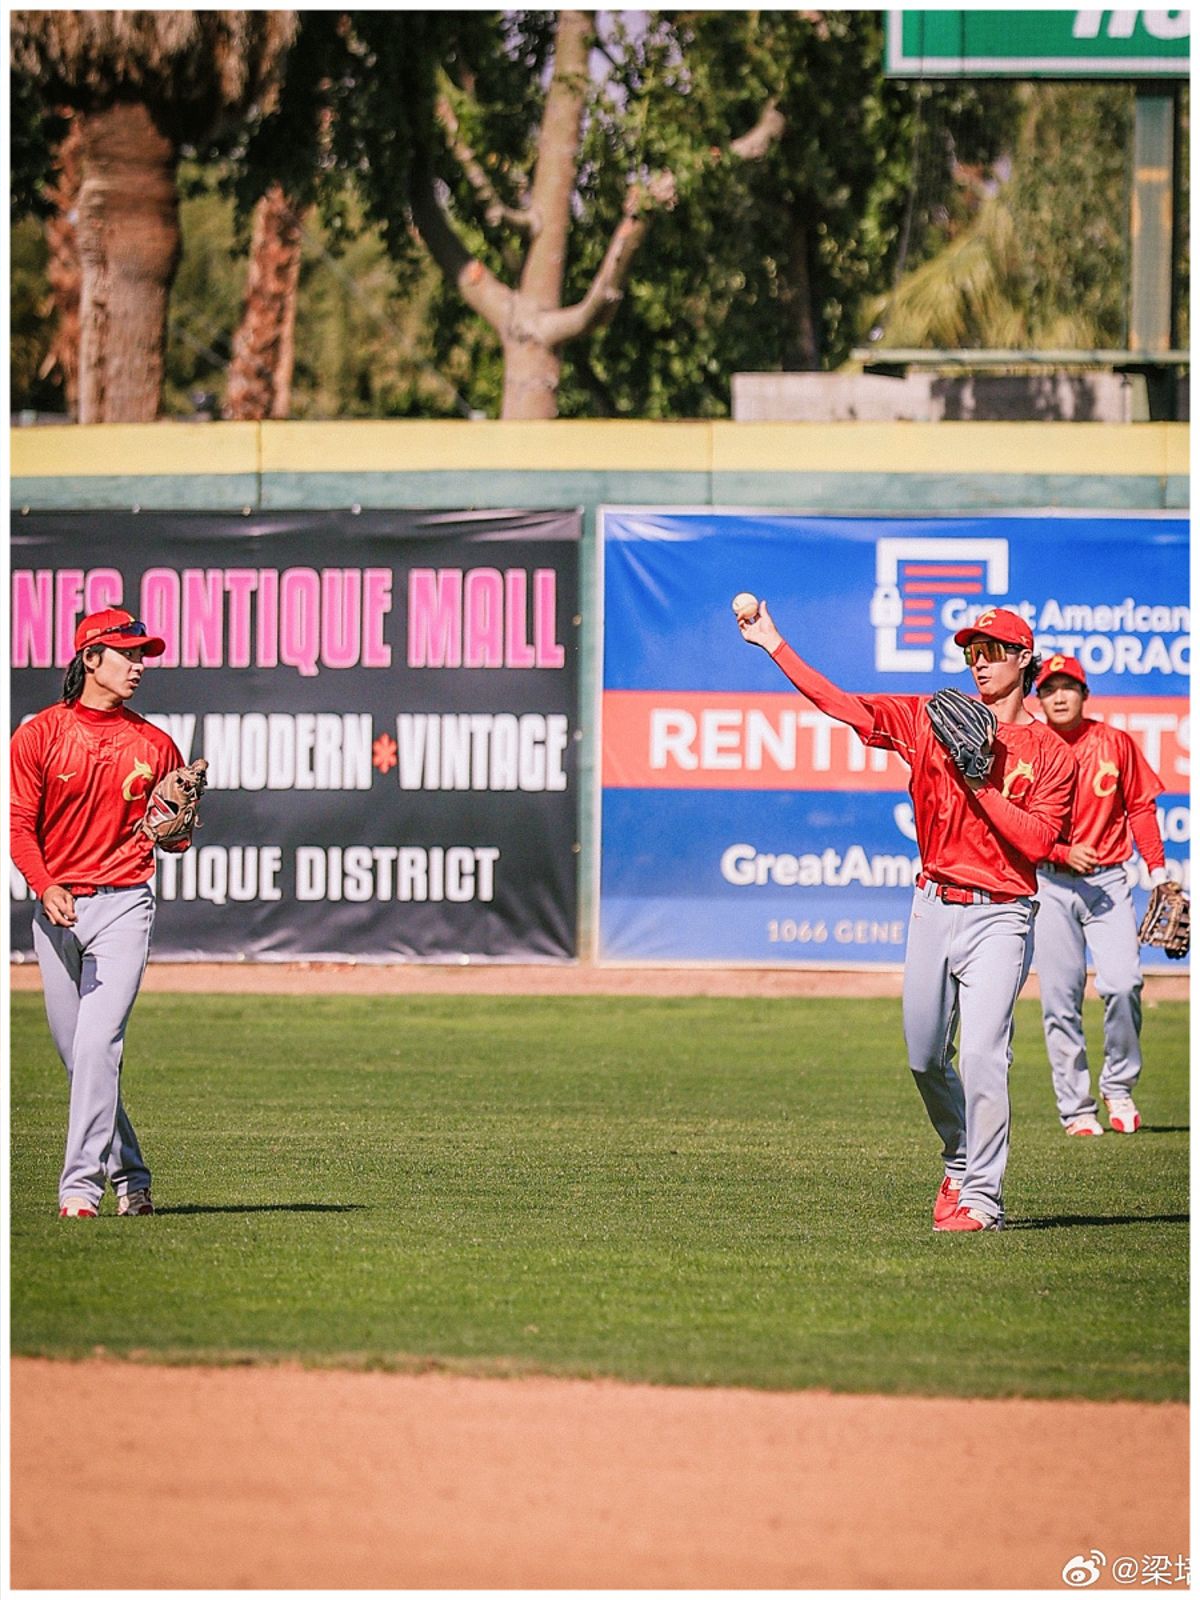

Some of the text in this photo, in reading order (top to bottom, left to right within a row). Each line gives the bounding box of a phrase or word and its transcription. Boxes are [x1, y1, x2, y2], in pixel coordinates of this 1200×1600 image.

[140, 567, 393, 677] ANTIQUE
[407, 567, 565, 669] MALL
[1040, 598, 1189, 633] American
[204, 713, 374, 790] MODERN
[397, 713, 568, 791] VINTAGE
[149, 845, 499, 904] TIQUE DISTRICT
[767, 918, 829, 943] 1066
